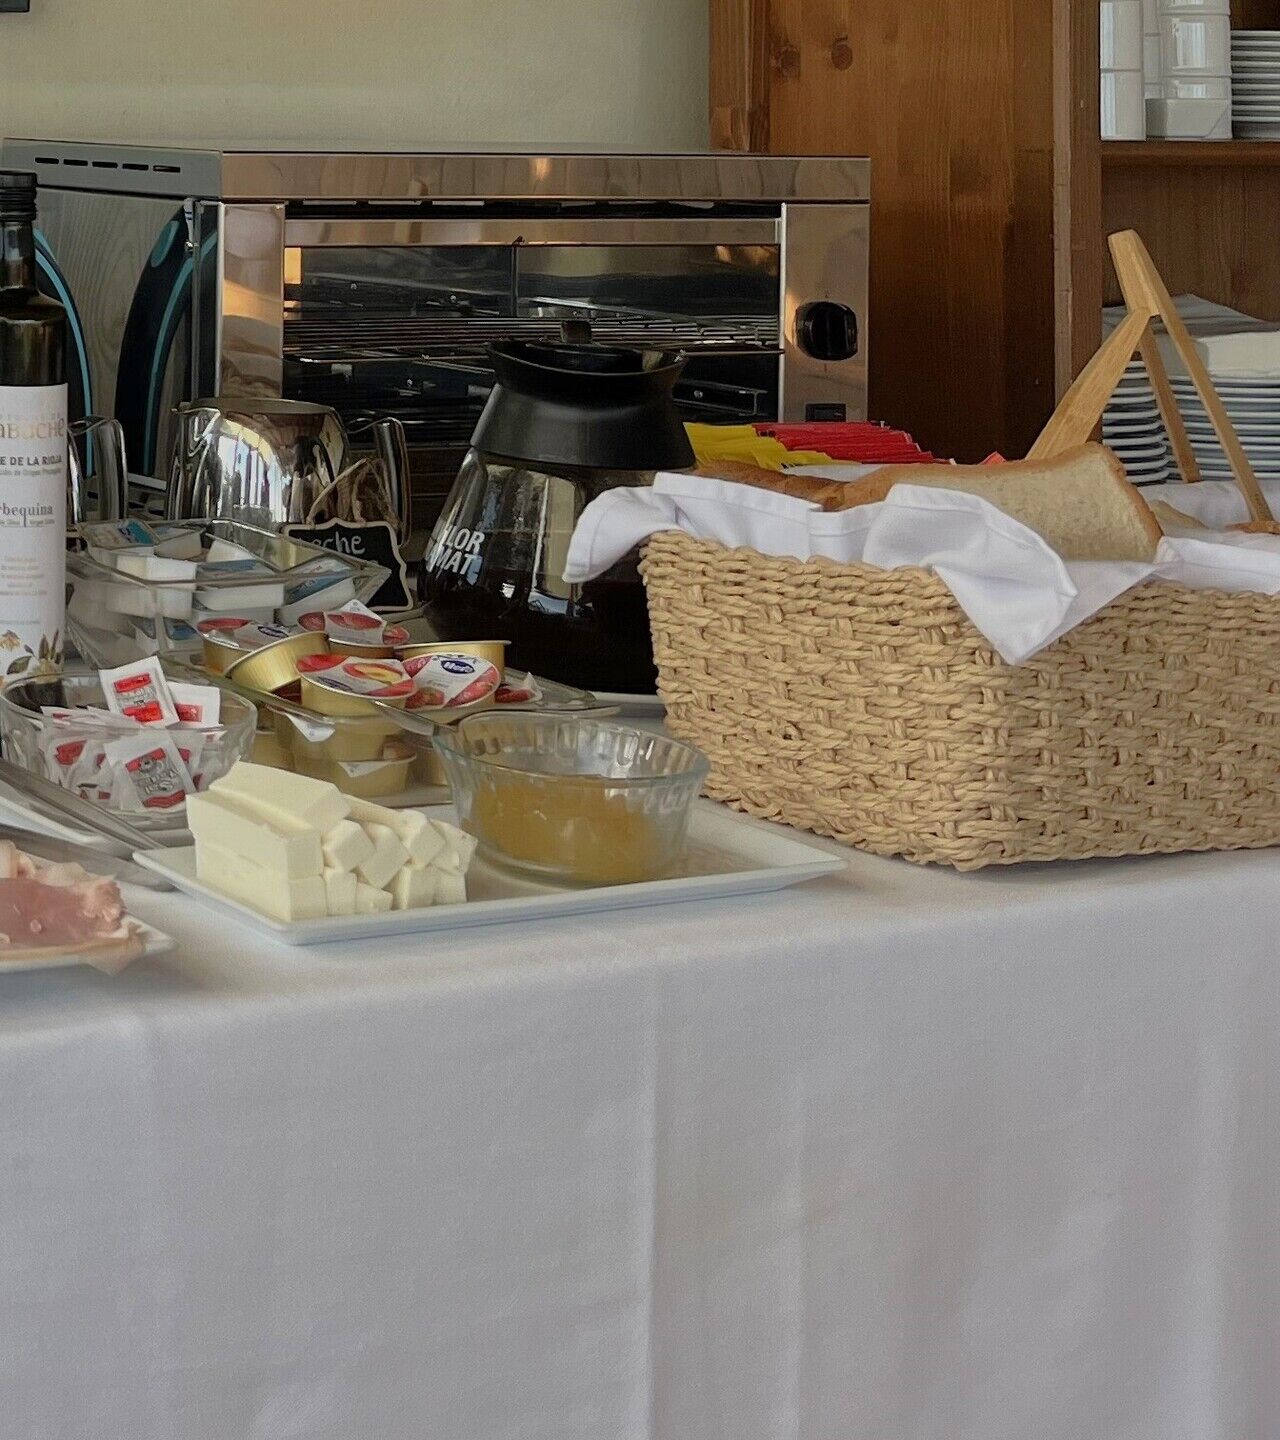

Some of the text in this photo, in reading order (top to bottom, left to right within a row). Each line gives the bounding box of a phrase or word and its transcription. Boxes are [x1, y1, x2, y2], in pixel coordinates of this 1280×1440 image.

[9, 457, 24, 466] DE
[27, 456, 40, 466] LA
[311, 531, 366, 555] che
